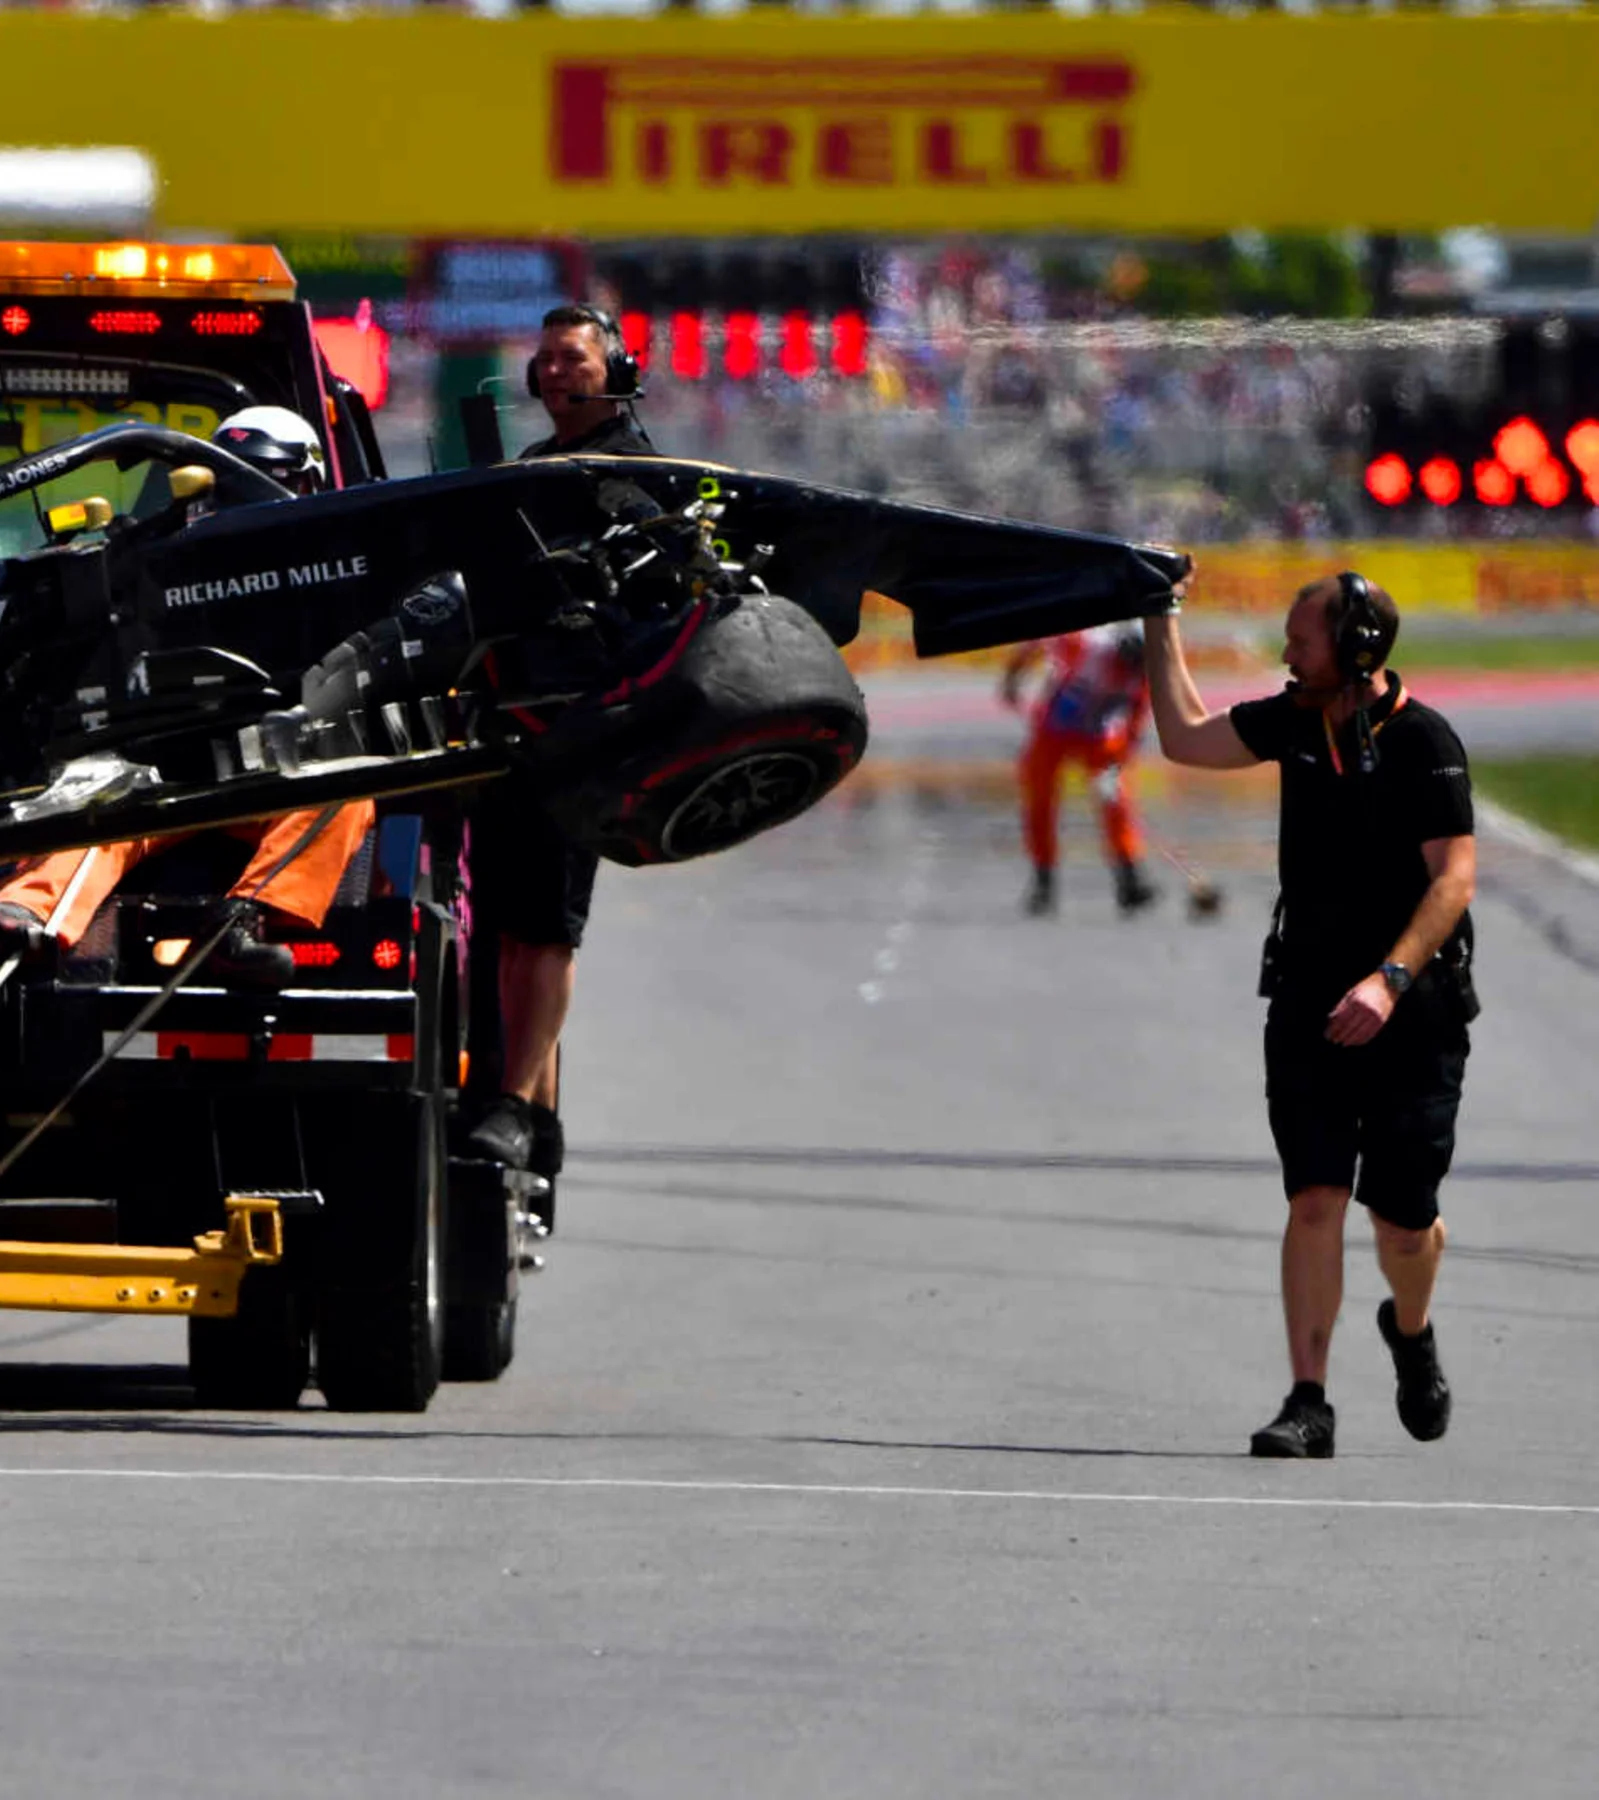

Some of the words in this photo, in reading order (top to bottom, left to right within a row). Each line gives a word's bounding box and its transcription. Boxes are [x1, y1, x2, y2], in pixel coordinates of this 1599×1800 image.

[550, 54, 1136, 186] PIRELLI
[164, 570, 281, 608] RICHARD
[287, 555, 369, 588] MILLE
